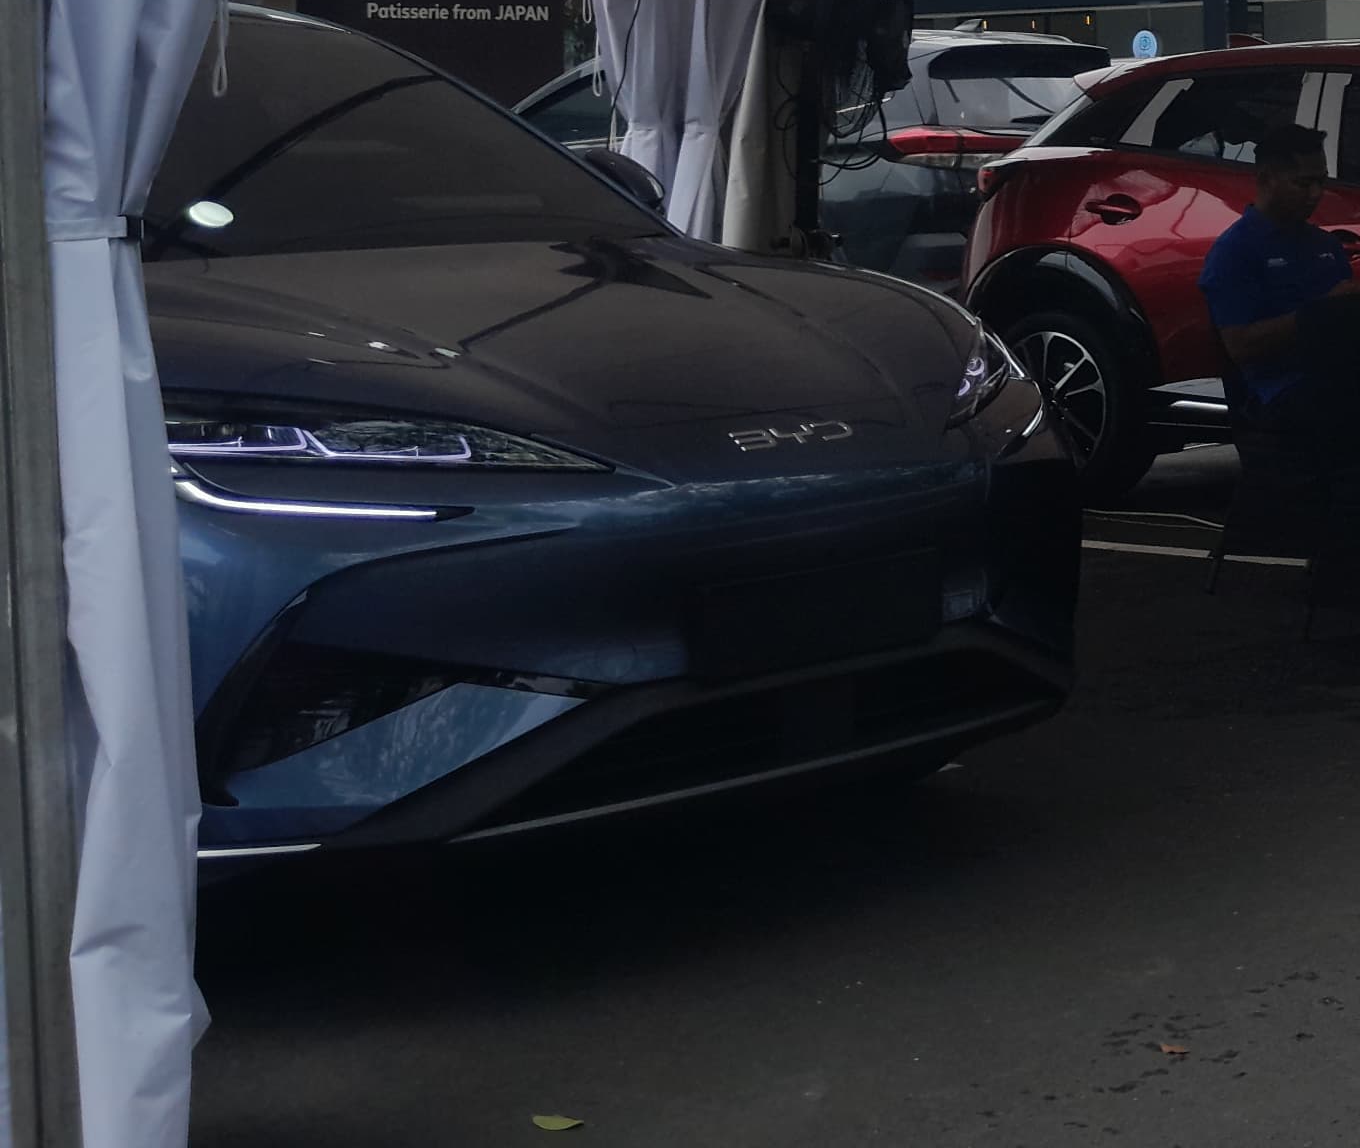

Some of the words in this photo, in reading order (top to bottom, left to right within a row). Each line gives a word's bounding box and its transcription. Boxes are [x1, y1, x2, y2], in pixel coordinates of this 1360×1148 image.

[366, 2, 450, 20] Patisserie
[451, 3, 492, 20] from
[494, 4, 550, 21] JAPAN
[727, 419, 854, 453] BYD
